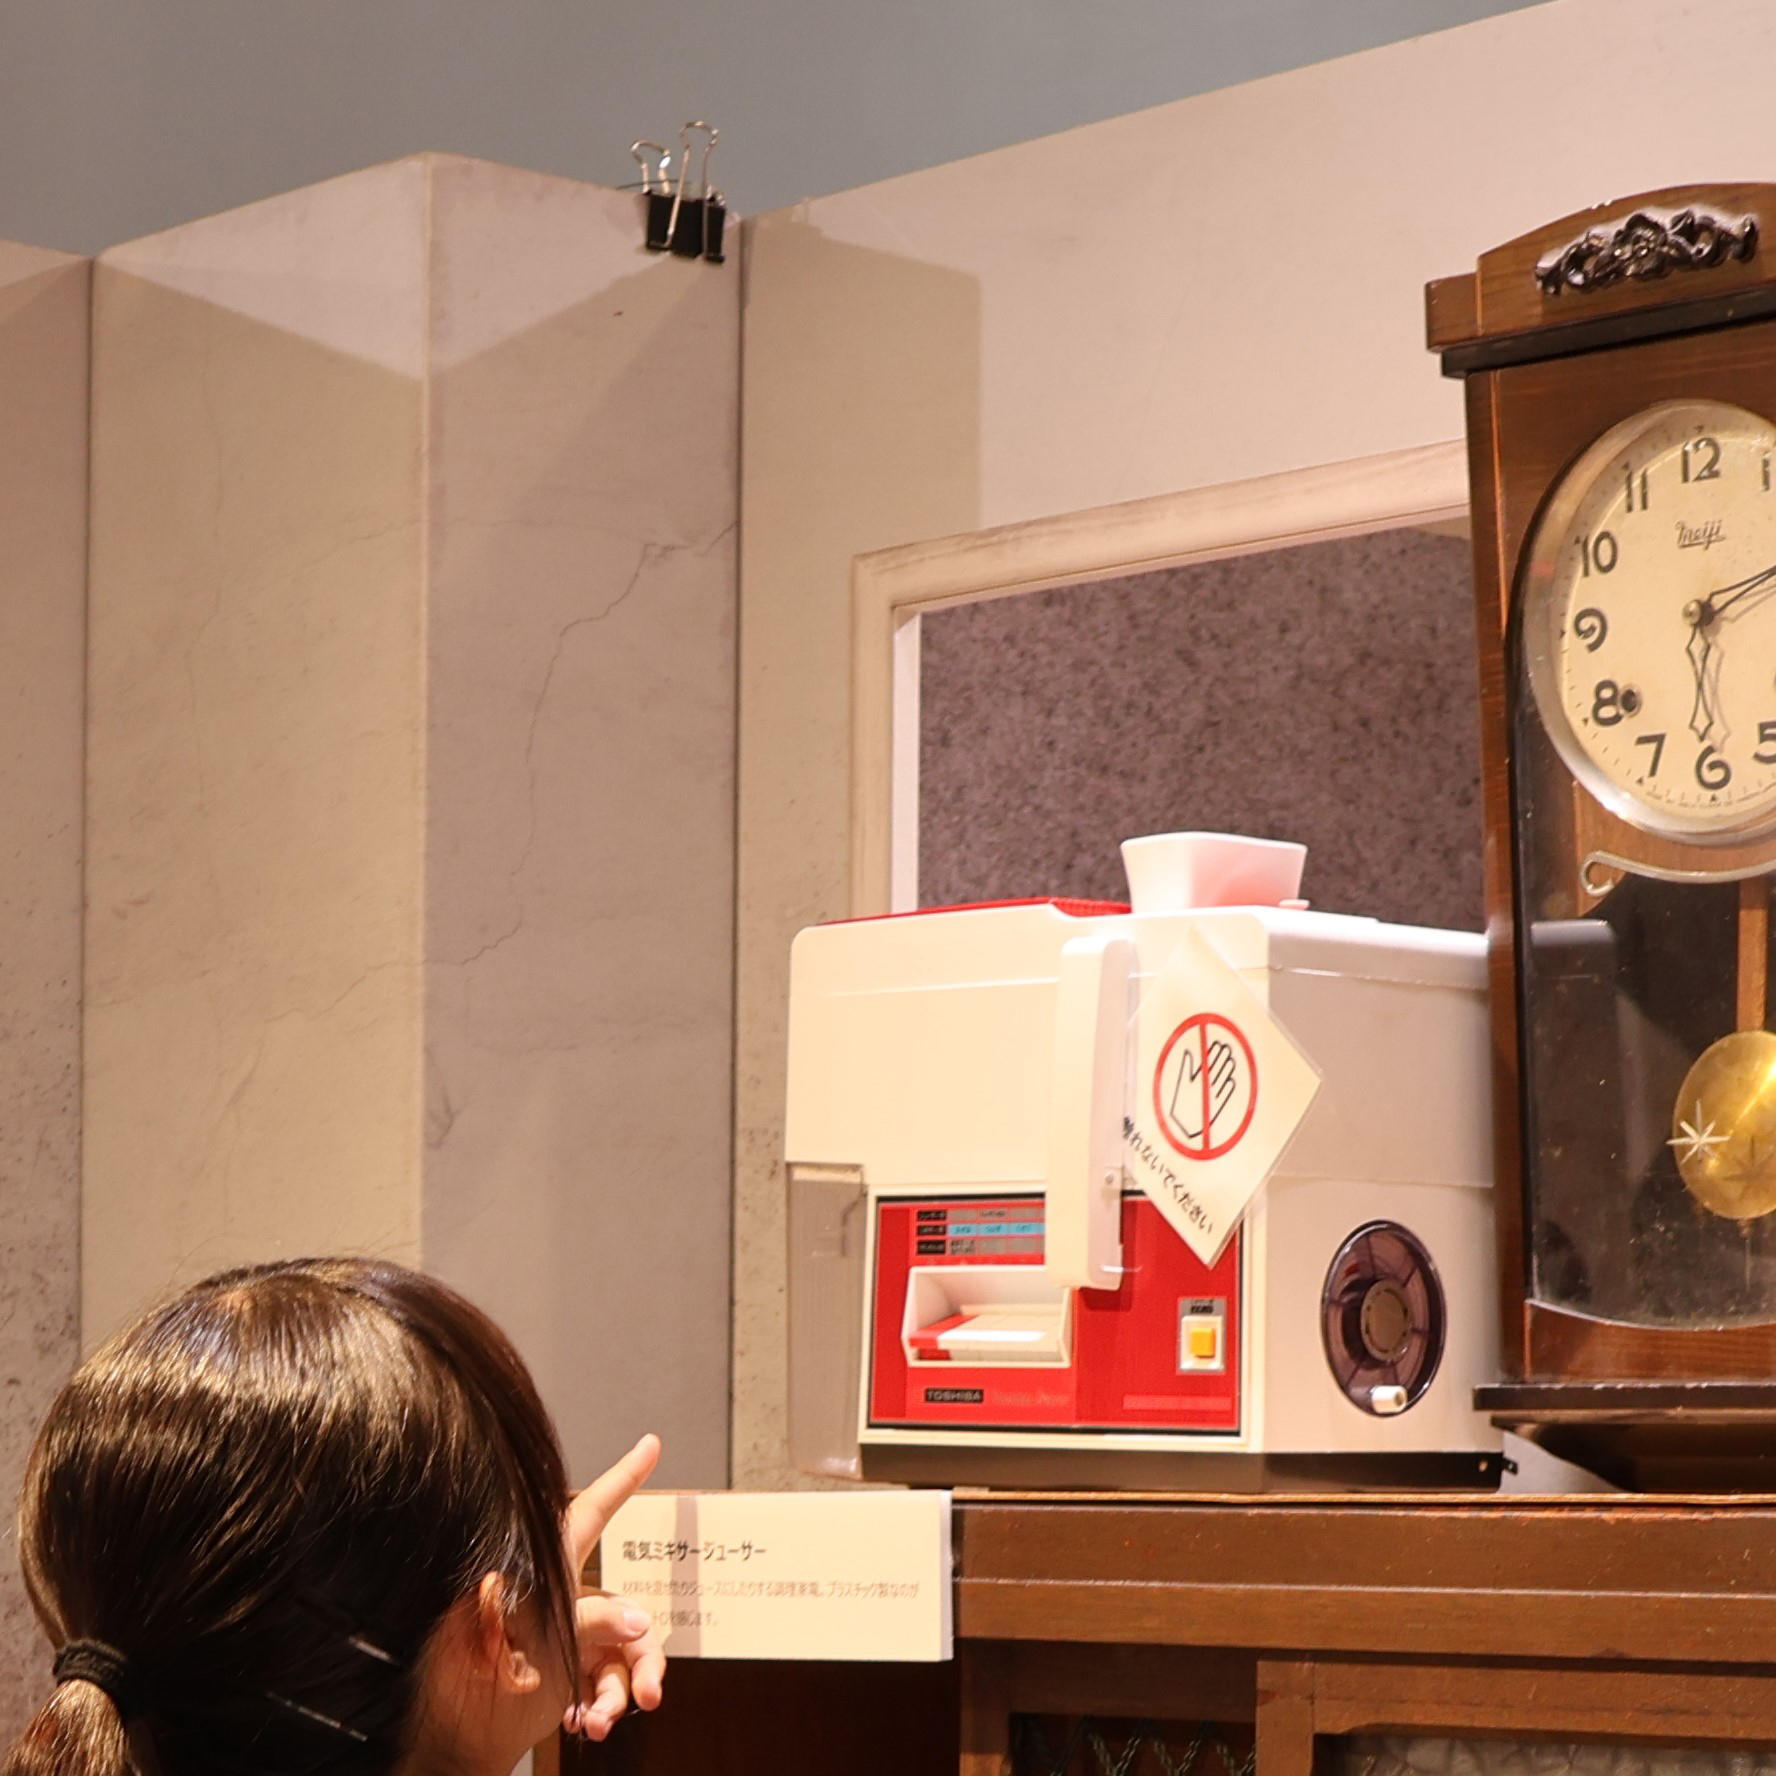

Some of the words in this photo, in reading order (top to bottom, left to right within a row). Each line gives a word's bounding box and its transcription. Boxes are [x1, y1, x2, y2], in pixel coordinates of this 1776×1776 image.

[1681, 437, 1720, 483] 12
[1760, 450, 1773, 492] 1
[1626, 467, 1648, 513] 11
[1581, 531, 1617, 577] 10
[1574, 608, 1608, 652] 9
[1592, 679, 1624, 727] 8
[1635, 733, 1666, 778] 7
[1695, 745, 1732, 791] 6
[927, 1390, 981, 1401] TOSHIBA
